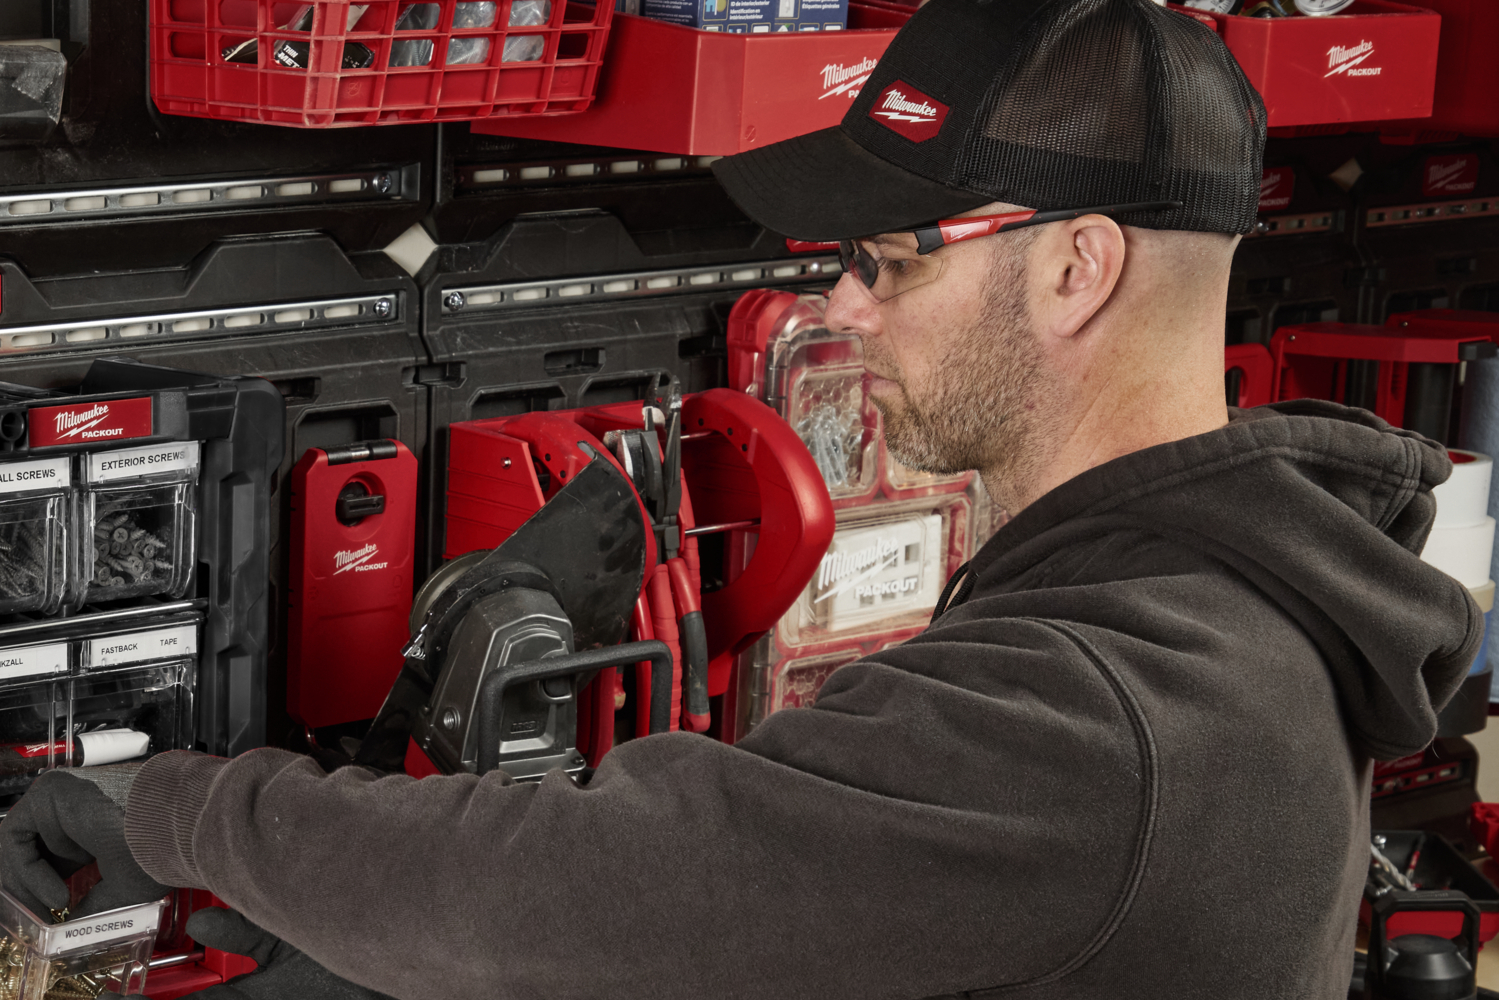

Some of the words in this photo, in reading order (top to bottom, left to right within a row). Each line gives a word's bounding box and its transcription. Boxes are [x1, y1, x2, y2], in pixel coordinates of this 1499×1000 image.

[1326, 39, 1374, 69] Milwaukee
[820, 56, 878, 90] Milwaukee
[1347, 67, 1383, 77] PACKOUT
[881, 89, 937, 117] Milwaukee
[53, 404, 110, 433] Milwaukee
[81, 428, 124, 439] PACKOUT
[101, 455, 146, 471] EXTERIOR
[147, 450, 186, 465] SCREWS
[16, 468, 57, 482] SCREWS
[333, 543, 378, 569] Milwaukee
[355, 561, 388, 573] PACKOUT
[855, 577, 918, 599] PACKOUT
[101, 643, 138, 655] FASTBACK
[160, 637, 178, 647] TAPE
[65, 926, 92, 939] WOOD
[95, 919, 134, 934] SCREWS
